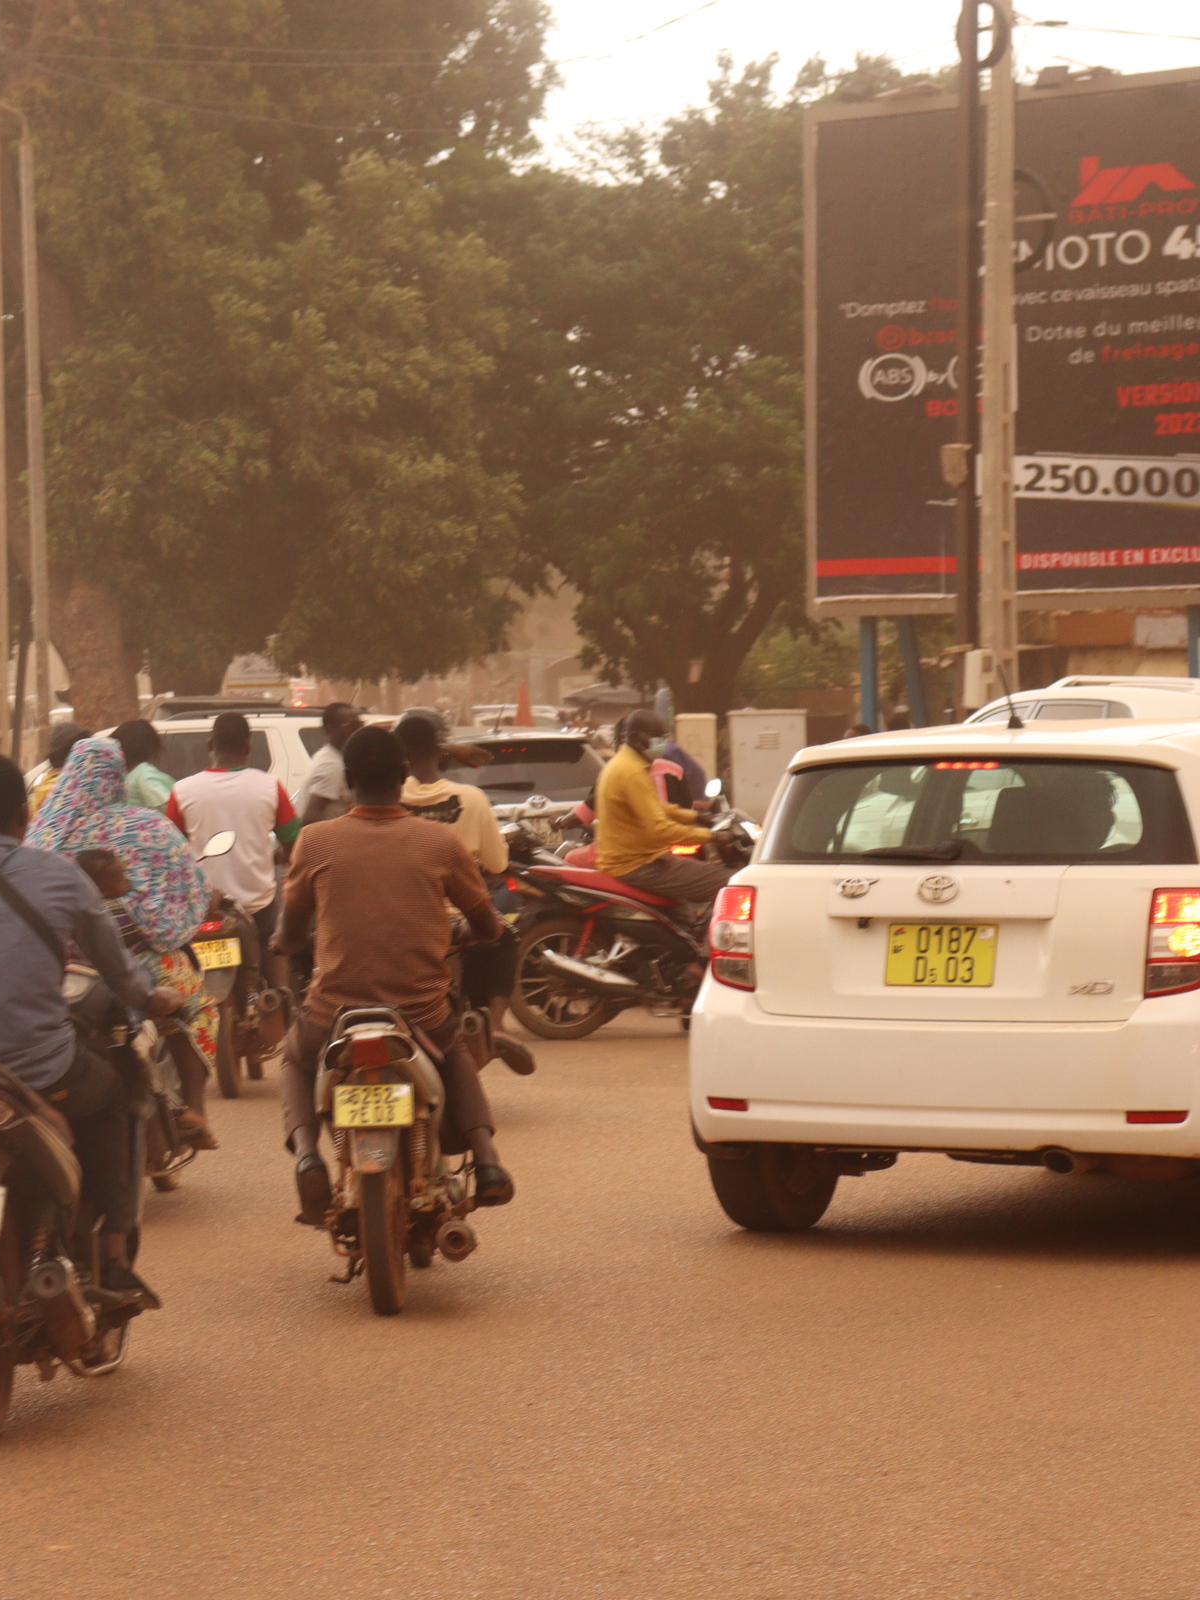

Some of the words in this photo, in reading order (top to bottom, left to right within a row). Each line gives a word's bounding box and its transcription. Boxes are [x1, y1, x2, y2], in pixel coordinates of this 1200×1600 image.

[1067, 198, 1198, 226] BATI-PRO
[1162, 224, 1200, 261] 4
[1014, 290, 1049, 306] vec
[1092, 320, 1122, 337] du
[1126, 312, 1200, 336] meille
[1068, 347, 1097, 365] de
[1101, 341, 1200, 362] freinage
[873, 368, 912, 386] ABS
[1115, 381, 1200, 409] VERSIO
[1021, 551, 1119, 570] DISPONIBLE
[1122, 550, 1145, 565] EN
[917, 926, 977, 954] 0187
[945, 956, 975, 983] 03
